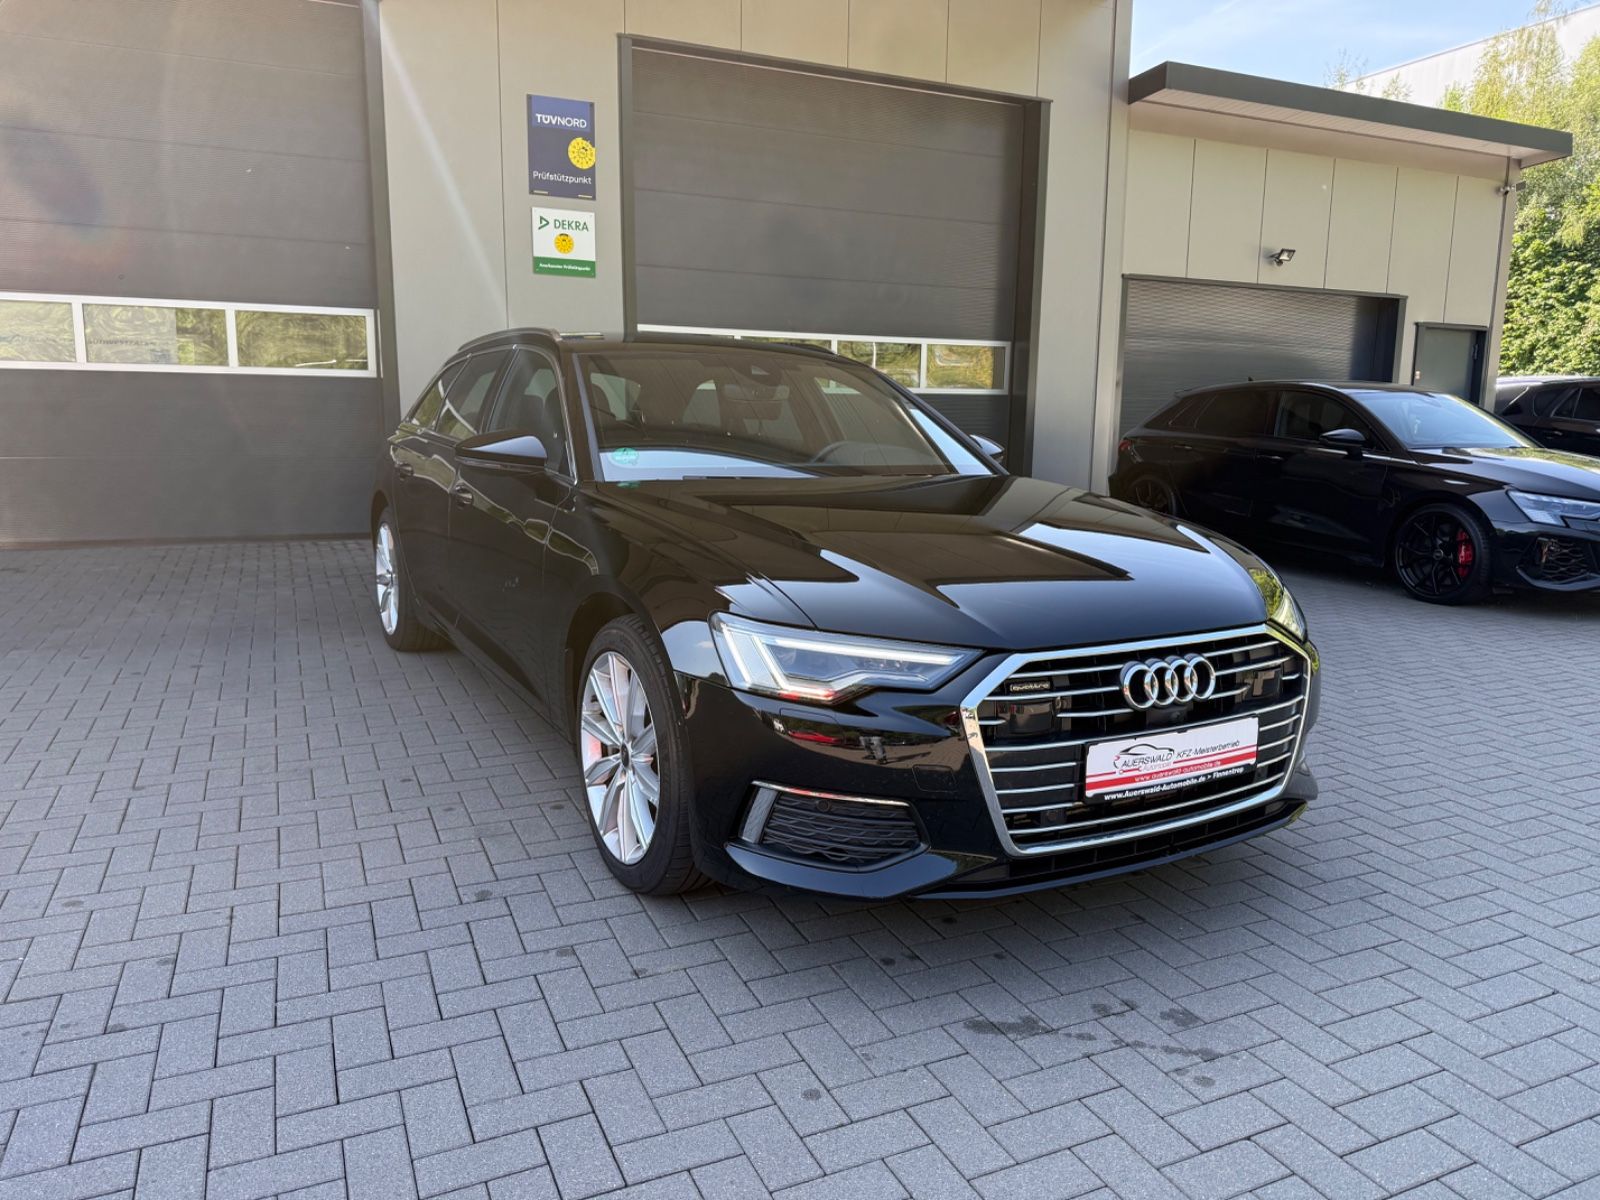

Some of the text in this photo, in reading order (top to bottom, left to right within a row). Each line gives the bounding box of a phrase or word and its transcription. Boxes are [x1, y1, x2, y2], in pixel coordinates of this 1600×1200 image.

[533, 170, 592, 185] Prüfstützpunkt
[553, 219, 589, 232] DEKRA
[1121, 740, 1240, 768] AUERSWALD KFZ-Meisterbetrieb
[1104, 766, 1244, 801] www.Auerswald-Automobile.de Finnentrop
